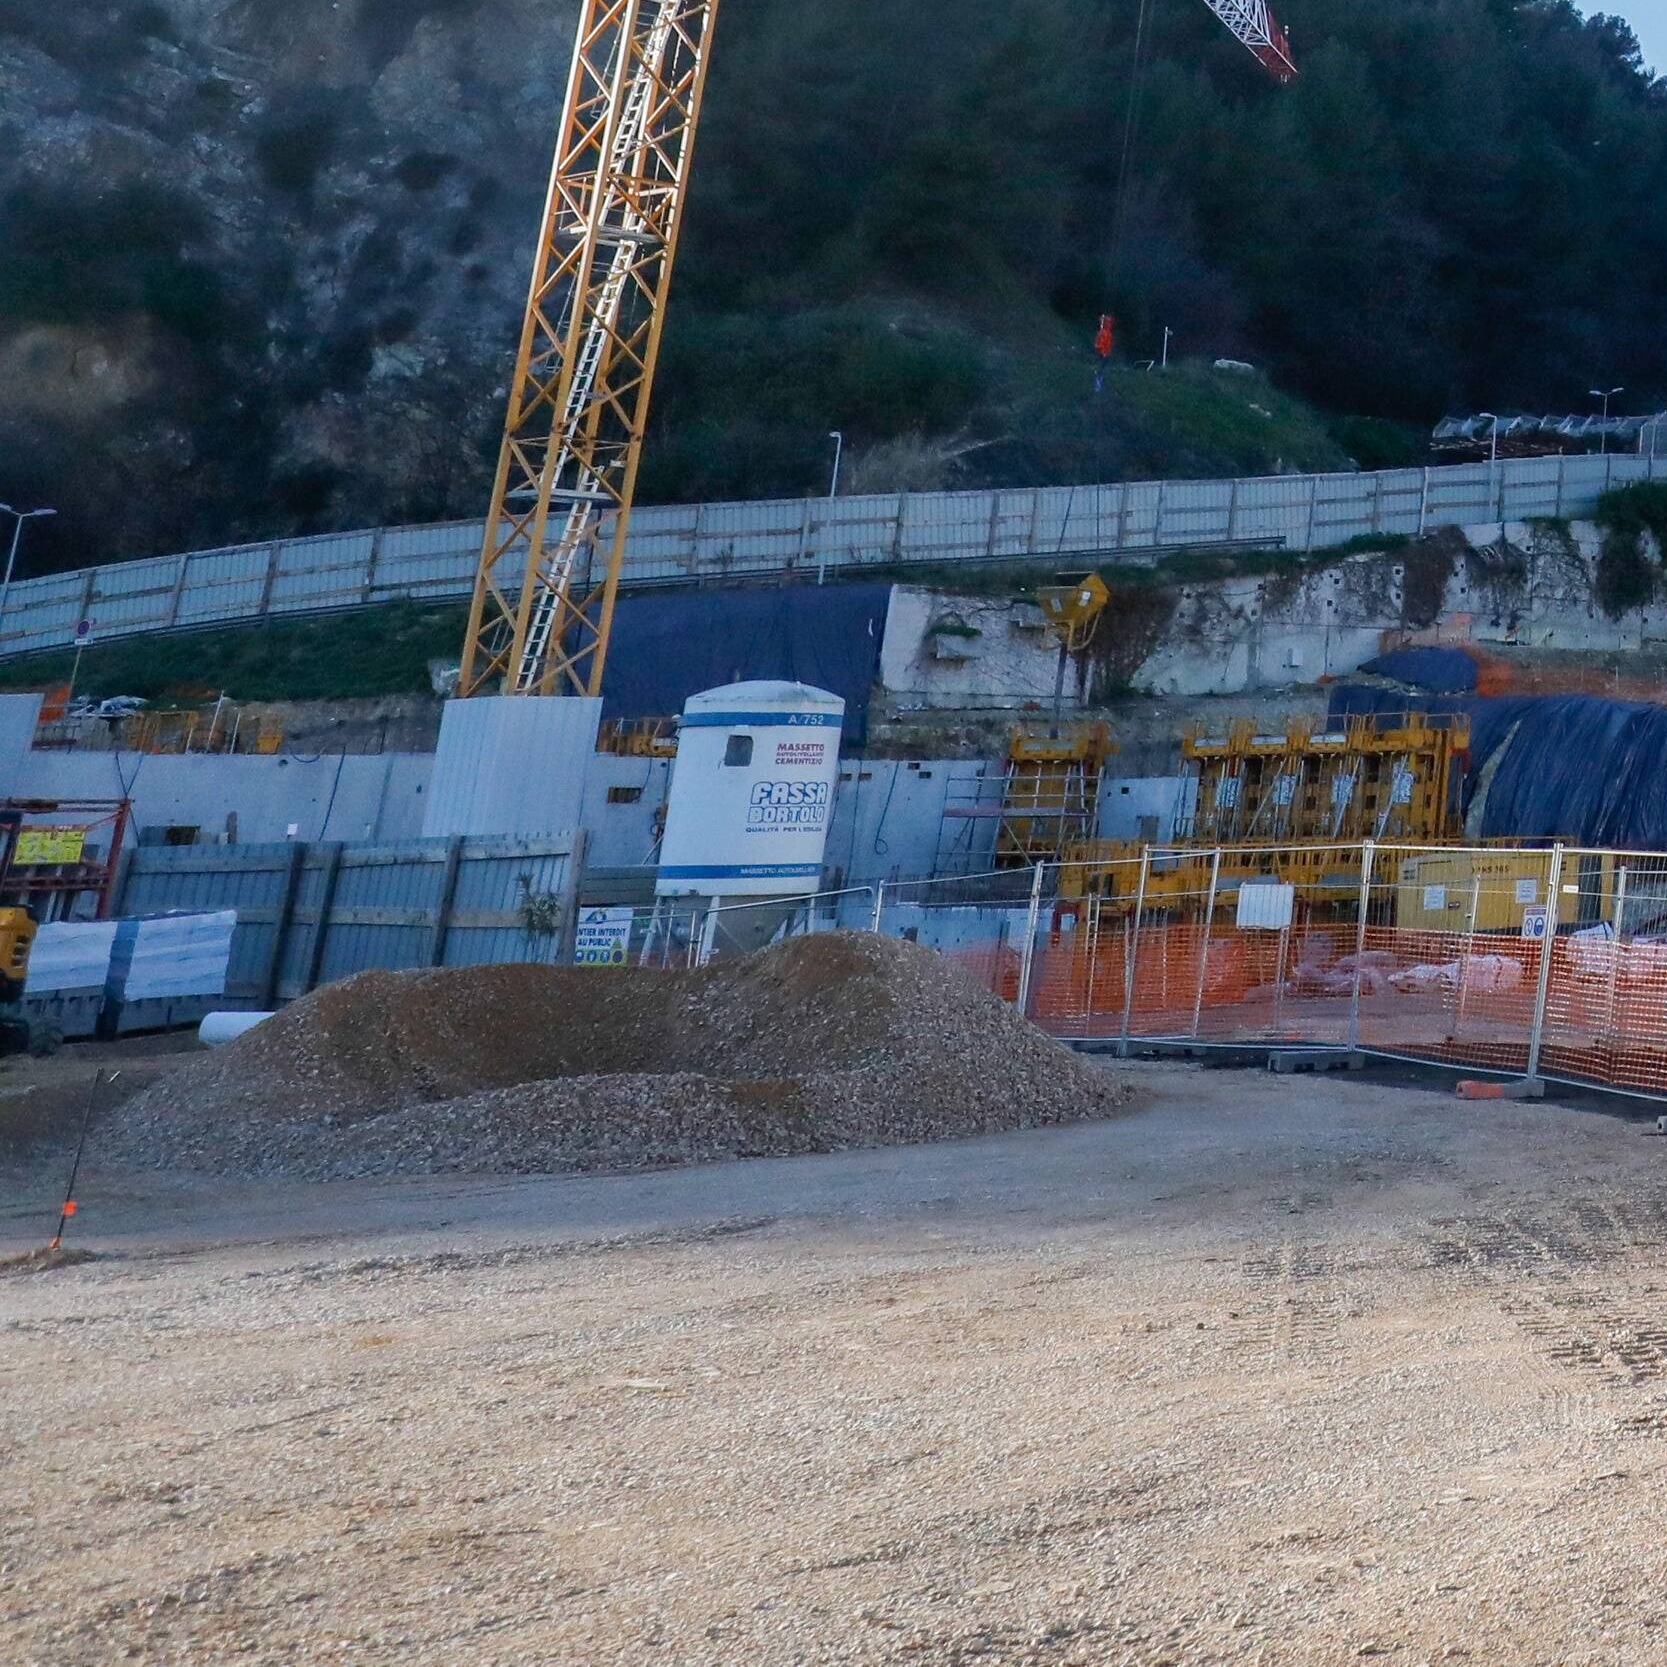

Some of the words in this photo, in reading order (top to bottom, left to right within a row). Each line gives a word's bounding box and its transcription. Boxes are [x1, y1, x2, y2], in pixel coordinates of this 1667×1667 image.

[777, 743, 824, 752] MASSETTO
[775, 758, 823, 766] CEMENTIZIO
[751, 782, 829, 805] FASSA
[748, 806, 825, 824] BORTOLO
